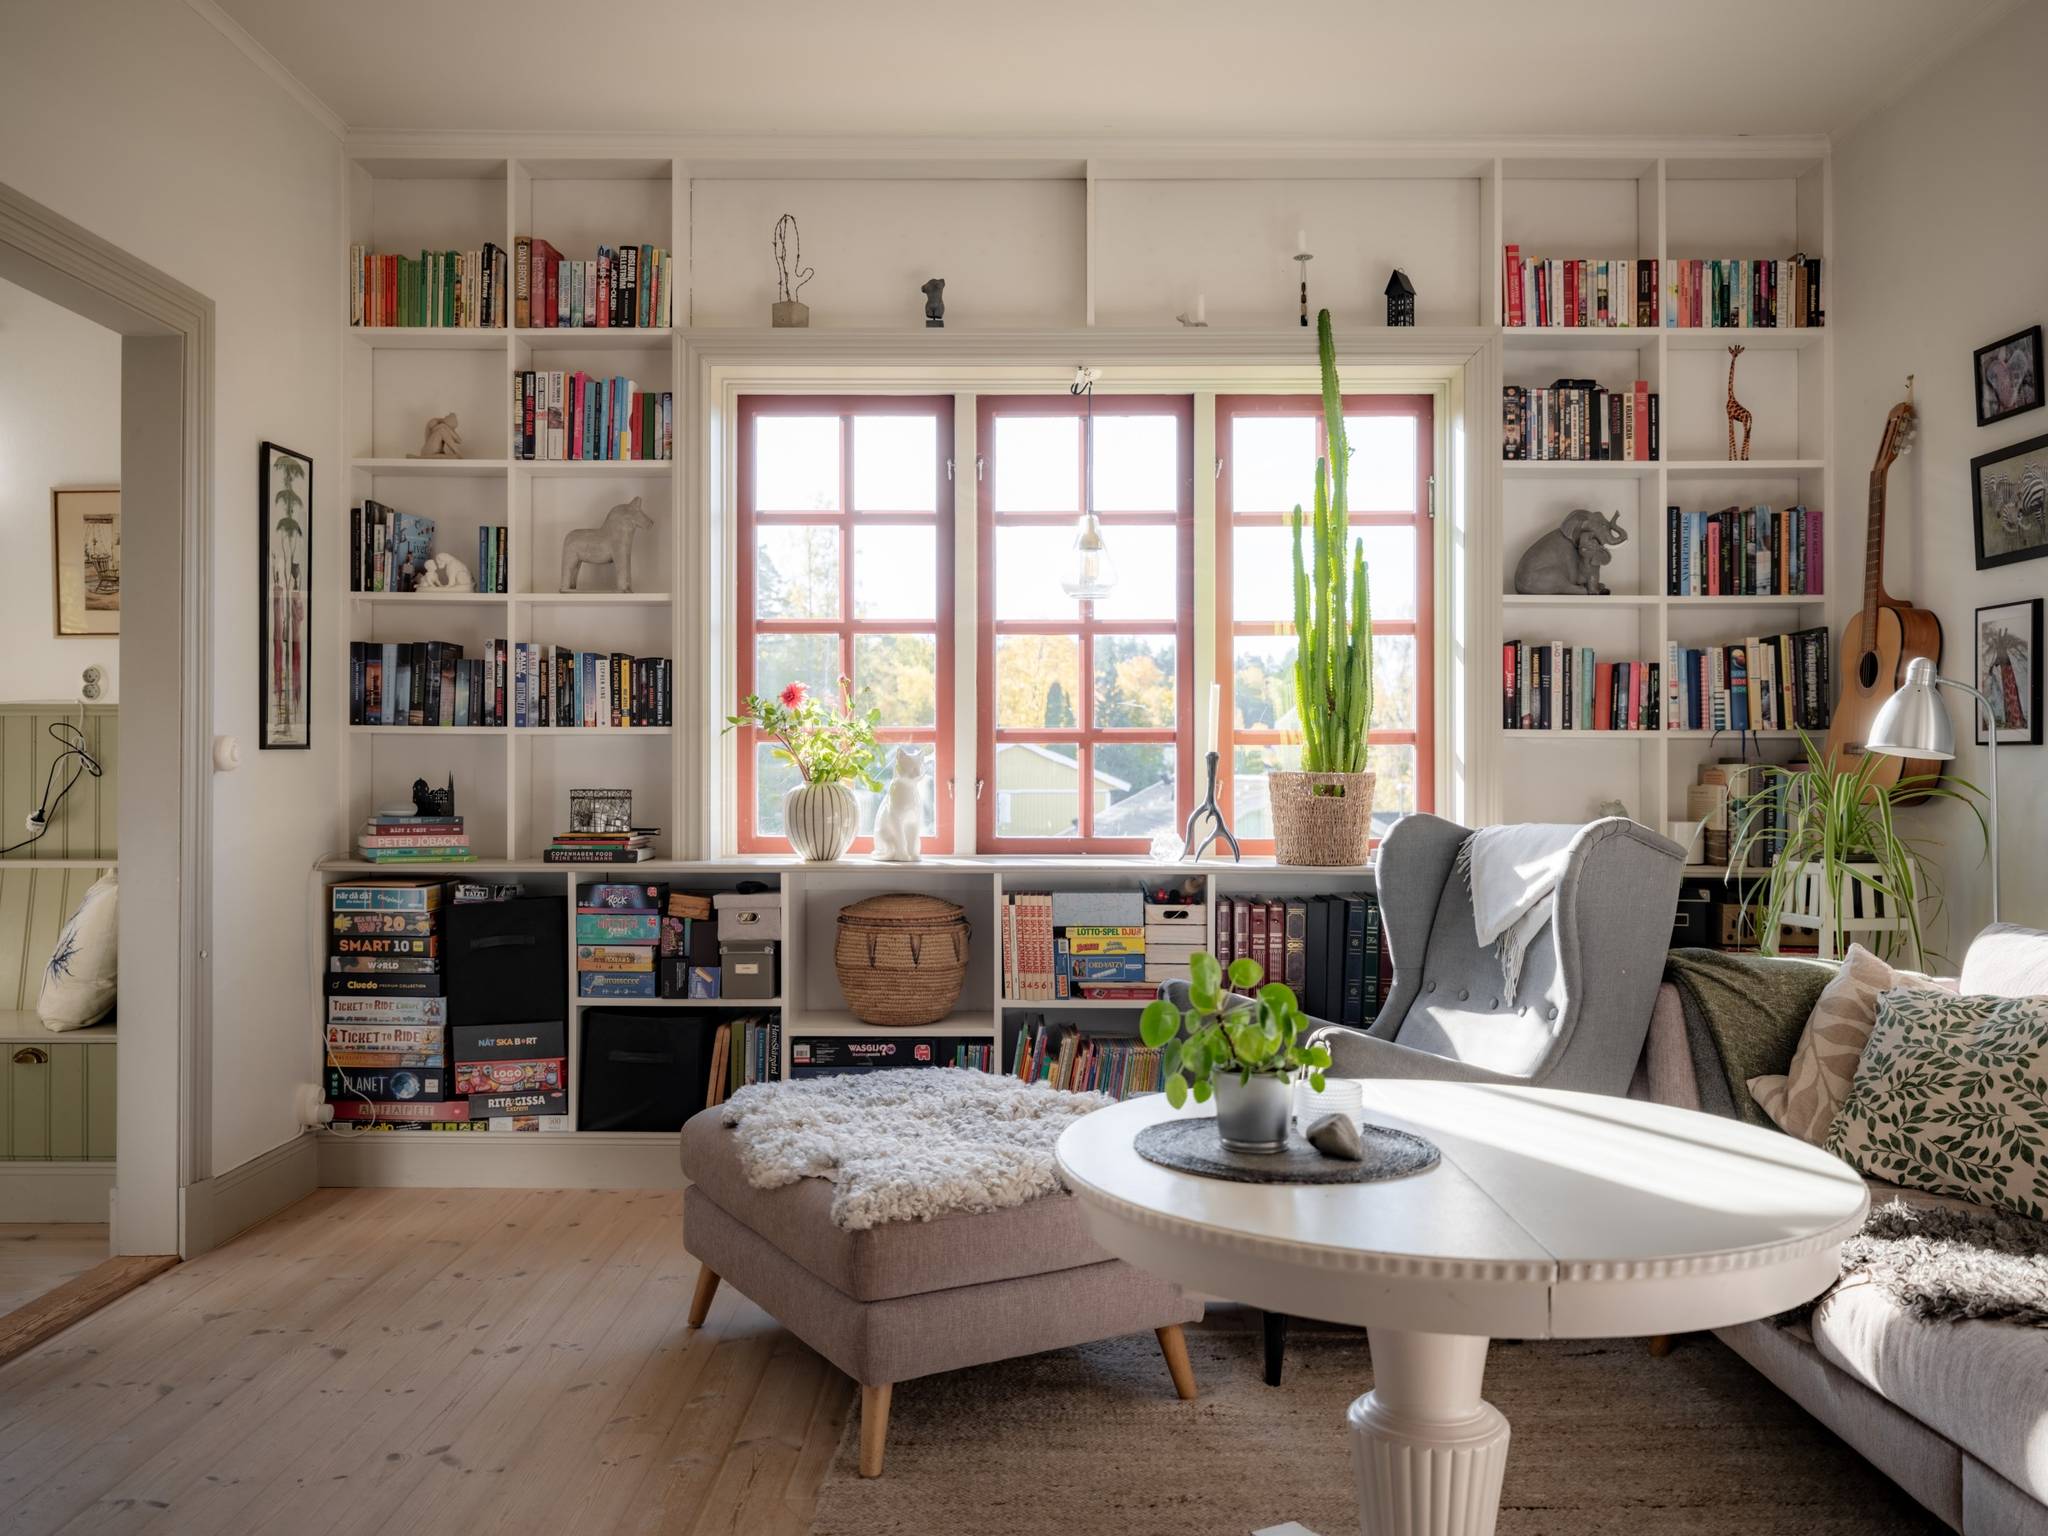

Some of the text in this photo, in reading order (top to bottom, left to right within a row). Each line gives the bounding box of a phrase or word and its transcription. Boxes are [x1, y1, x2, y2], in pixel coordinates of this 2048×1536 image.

[627, 249, 636, 281] ROSLUND
[518, 245, 527, 296] DAN BROWN
[378, 838, 414, 847] PETER
[1077, 928, 1142, 936] LOTTO-SPEL DJUR
[339, 939, 410, 952] SMART 10
[346, 981, 378, 990] Cluedo
[1041, 981, 1047, 989] 6
[496, 1037, 514, 1046] SKA
[493, 1069, 522, 1078] LOGO
[343, 1076, 389, 1095] PLANET
[488, 1099, 511, 1108] RITA
[516, 1096, 546, 1106] GISSA
